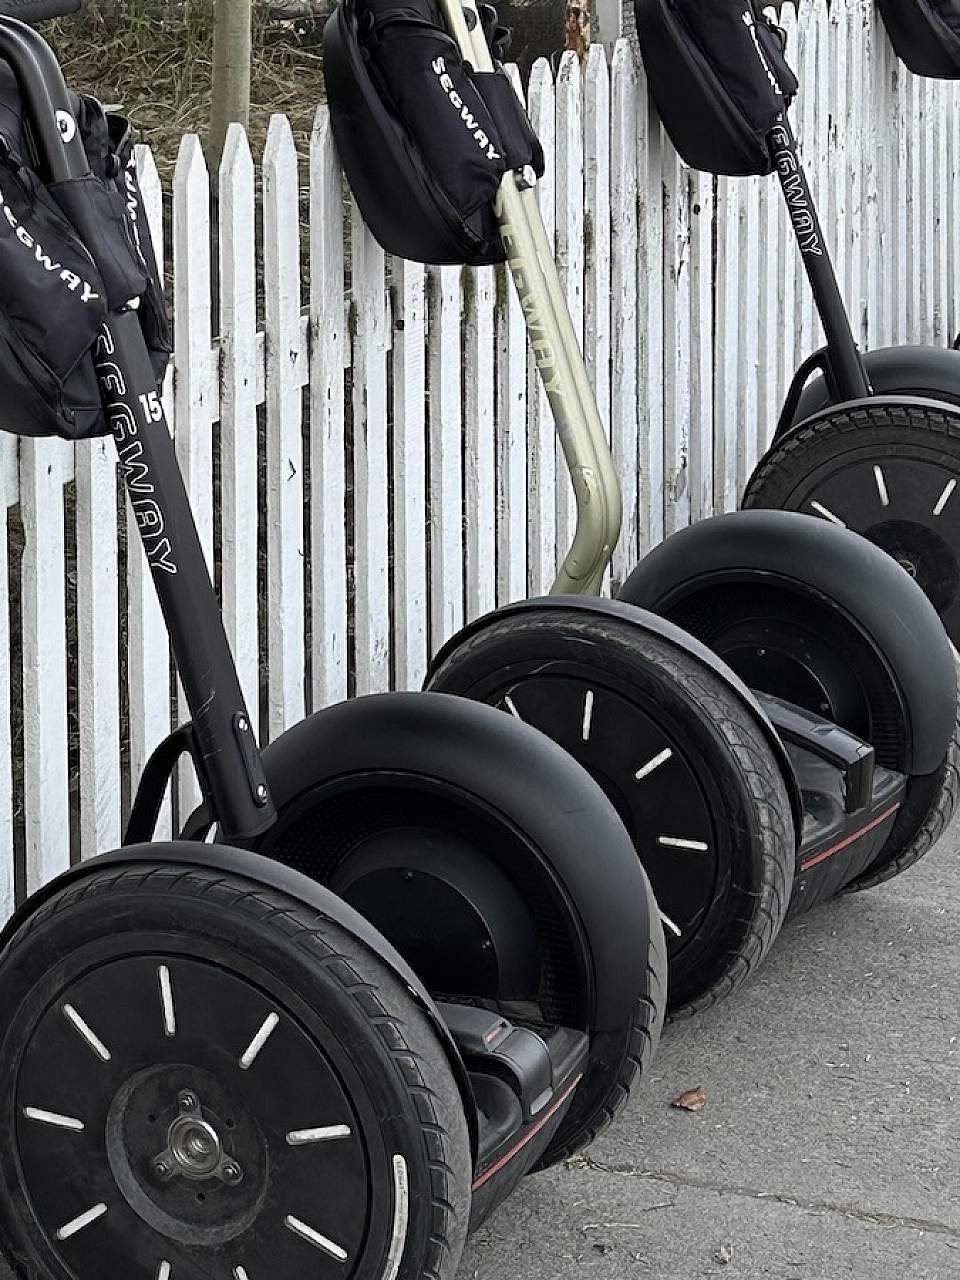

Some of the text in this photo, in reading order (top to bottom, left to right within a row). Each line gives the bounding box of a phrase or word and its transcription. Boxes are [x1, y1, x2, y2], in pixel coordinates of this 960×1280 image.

[432, 56, 501, 160] SEGWAY
[771, 113, 823, 256] EGWAY
[95, 322, 177, 575] SEGWAY
[138, 389, 162, 424] 15
